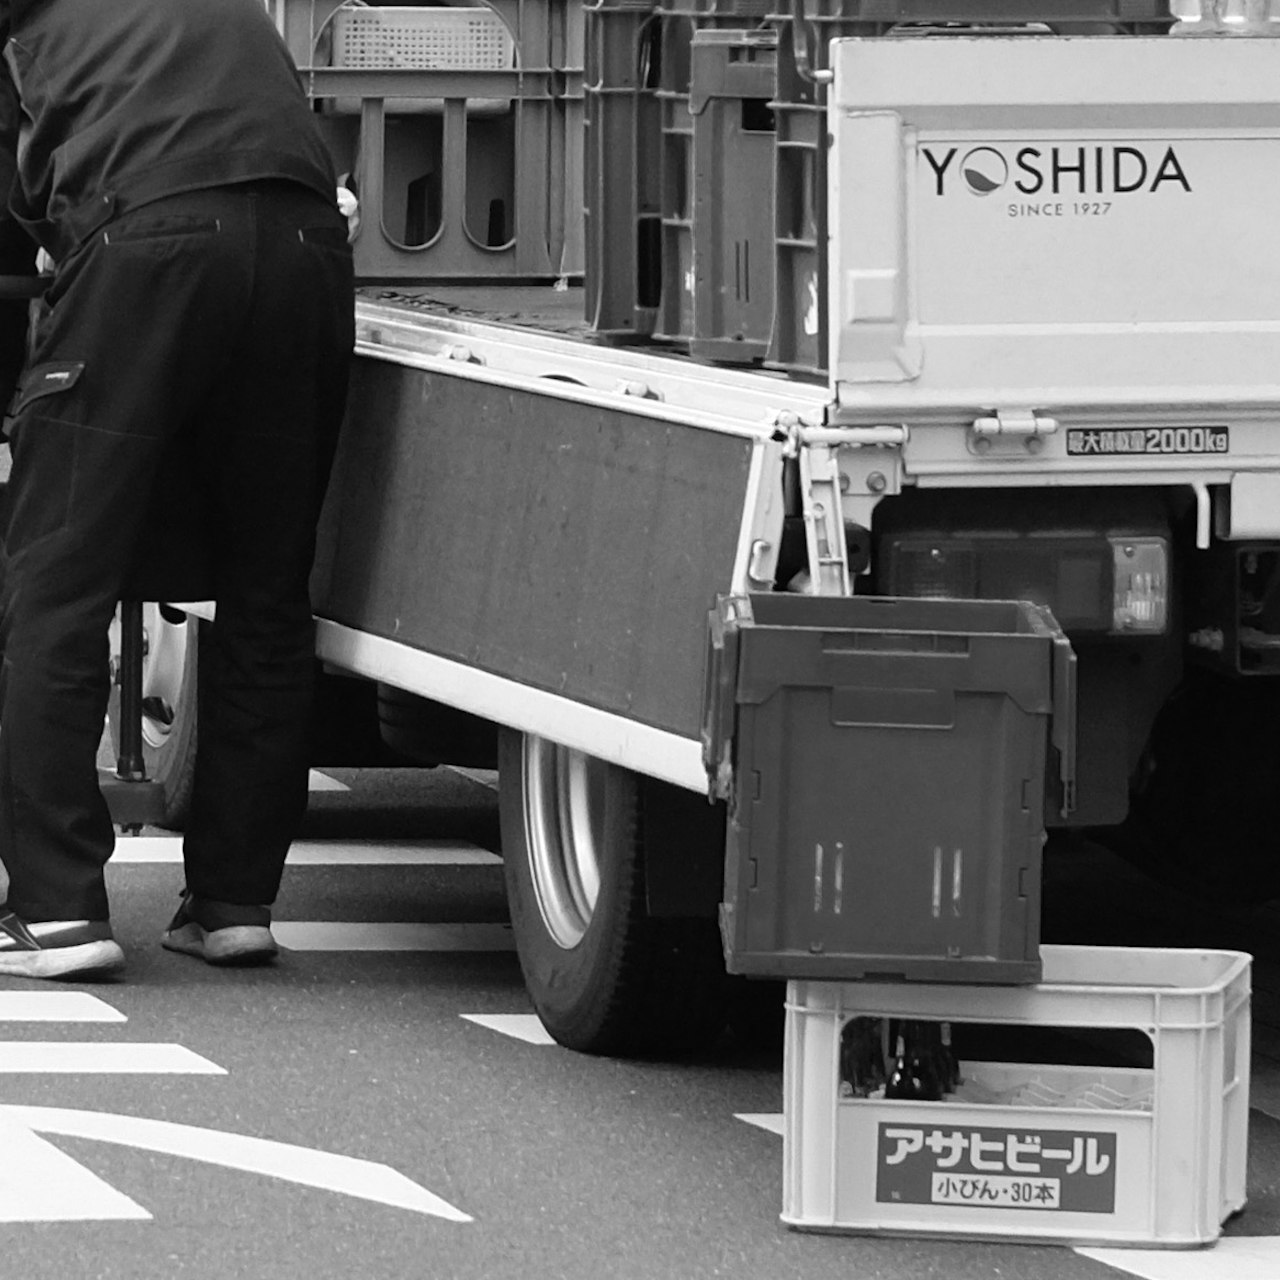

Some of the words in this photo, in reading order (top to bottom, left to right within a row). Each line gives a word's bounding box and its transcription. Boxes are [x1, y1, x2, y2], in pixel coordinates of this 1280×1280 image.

[922, 146, 1192, 197] YOSHIDA
[1008, 203, 1064, 217] SINCE
[1072, 202, 1112, 215] 1927
[884, 1128, 1111, 1175] アサヒビール
[937, 1176, 1056, 1204] 小びん・30本
